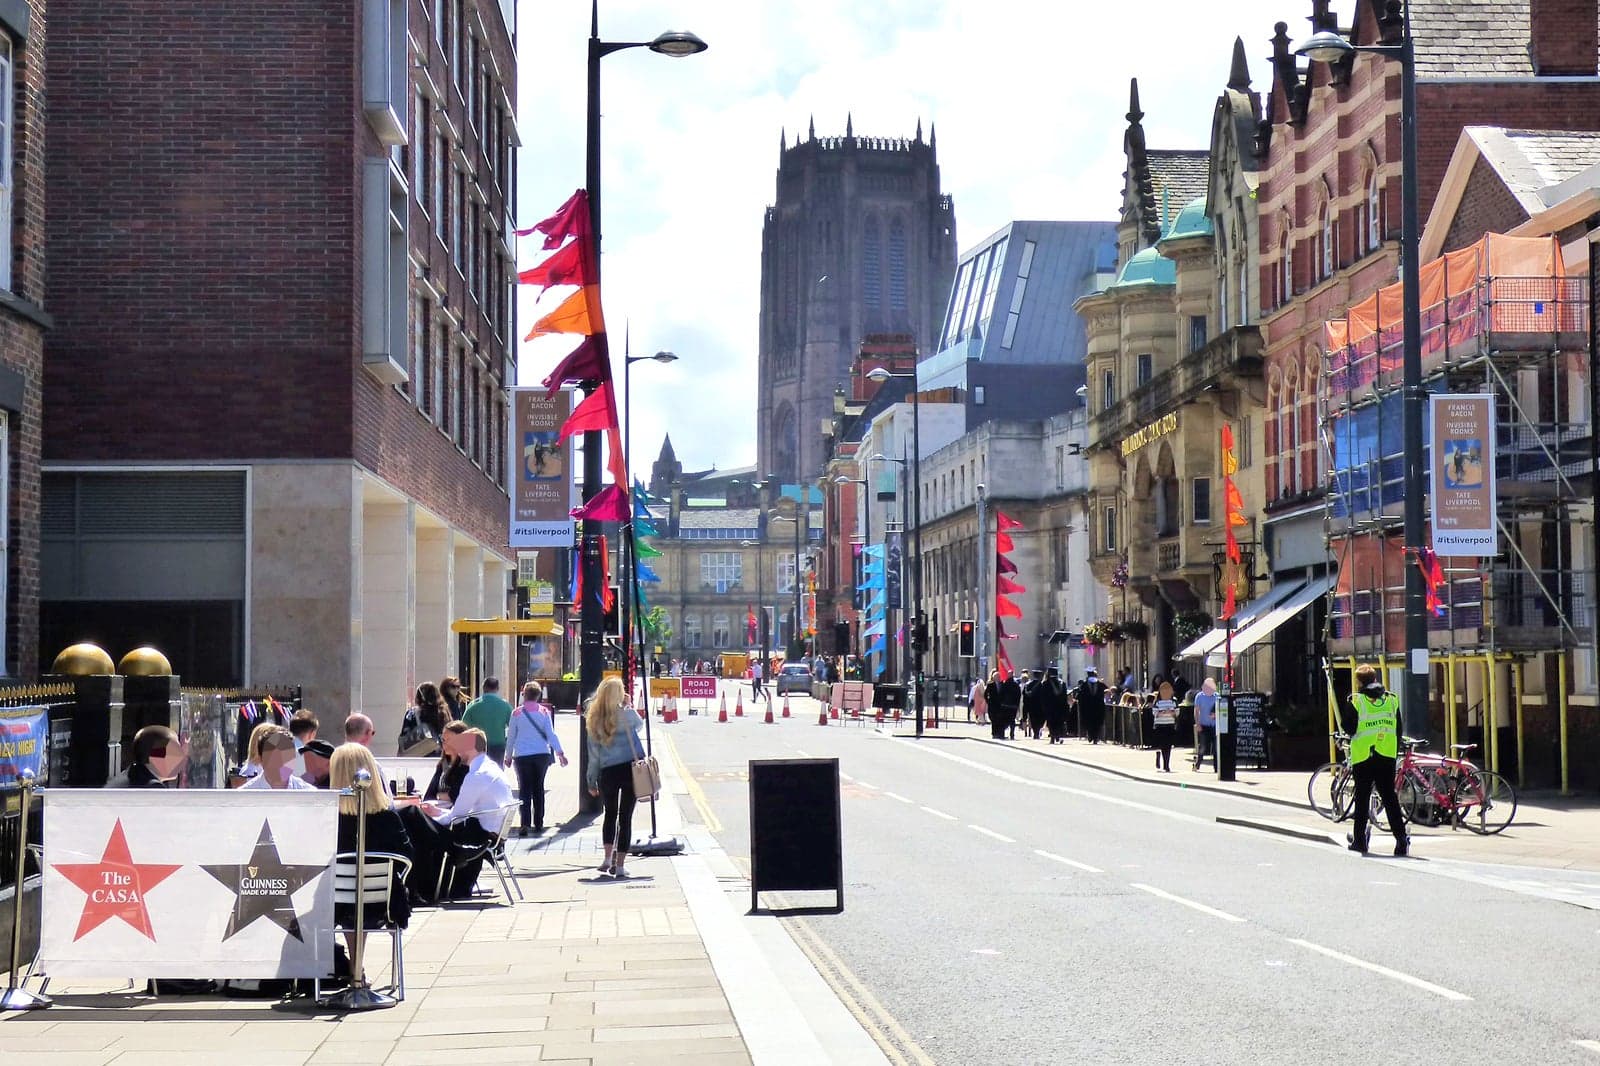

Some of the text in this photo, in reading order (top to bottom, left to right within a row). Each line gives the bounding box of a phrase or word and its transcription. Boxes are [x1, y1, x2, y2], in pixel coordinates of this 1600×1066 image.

[514, 528, 570, 536] #itsliverpool
[1437, 536, 1492, 544] #itsliverpool
[18, 740, 36, 756] NIGHT
[101, 871, 130, 885] The
[242, 878, 288, 888] GUINNESS
[92, 888, 140, 904] CASA
